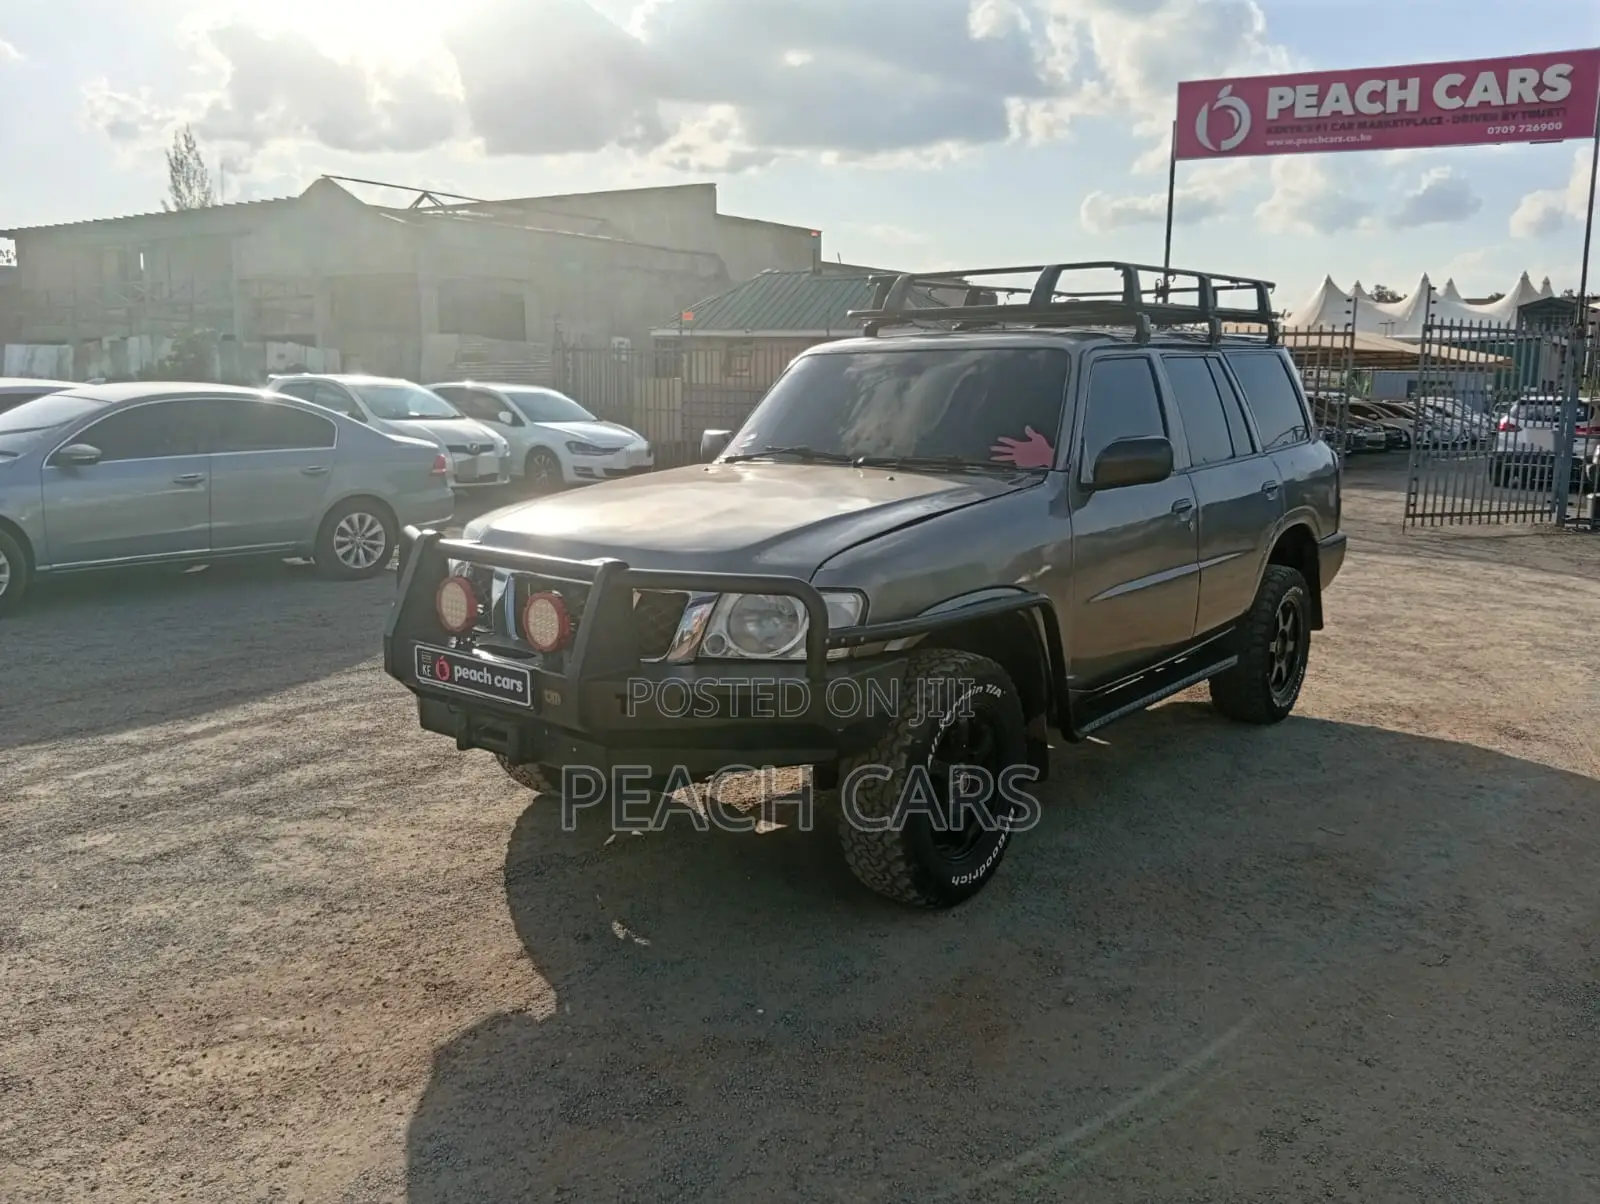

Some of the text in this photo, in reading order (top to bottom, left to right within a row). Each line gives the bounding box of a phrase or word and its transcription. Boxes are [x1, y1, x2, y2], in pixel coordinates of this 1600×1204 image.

[1266, 63, 1574, 120] PEACH CARS
[1331, 121, 1355, 131] CAR
[1357, 116, 1443, 130] MARKETPLACE
[1452, 112, 1499, 125] DRIVEN
[1502, 110, 1517, 121] BY
[1487, 121, 1563, 135] 0709 726900
[422, 664, 432, 676] KE
[454, 665, 524, 693] peach cars
